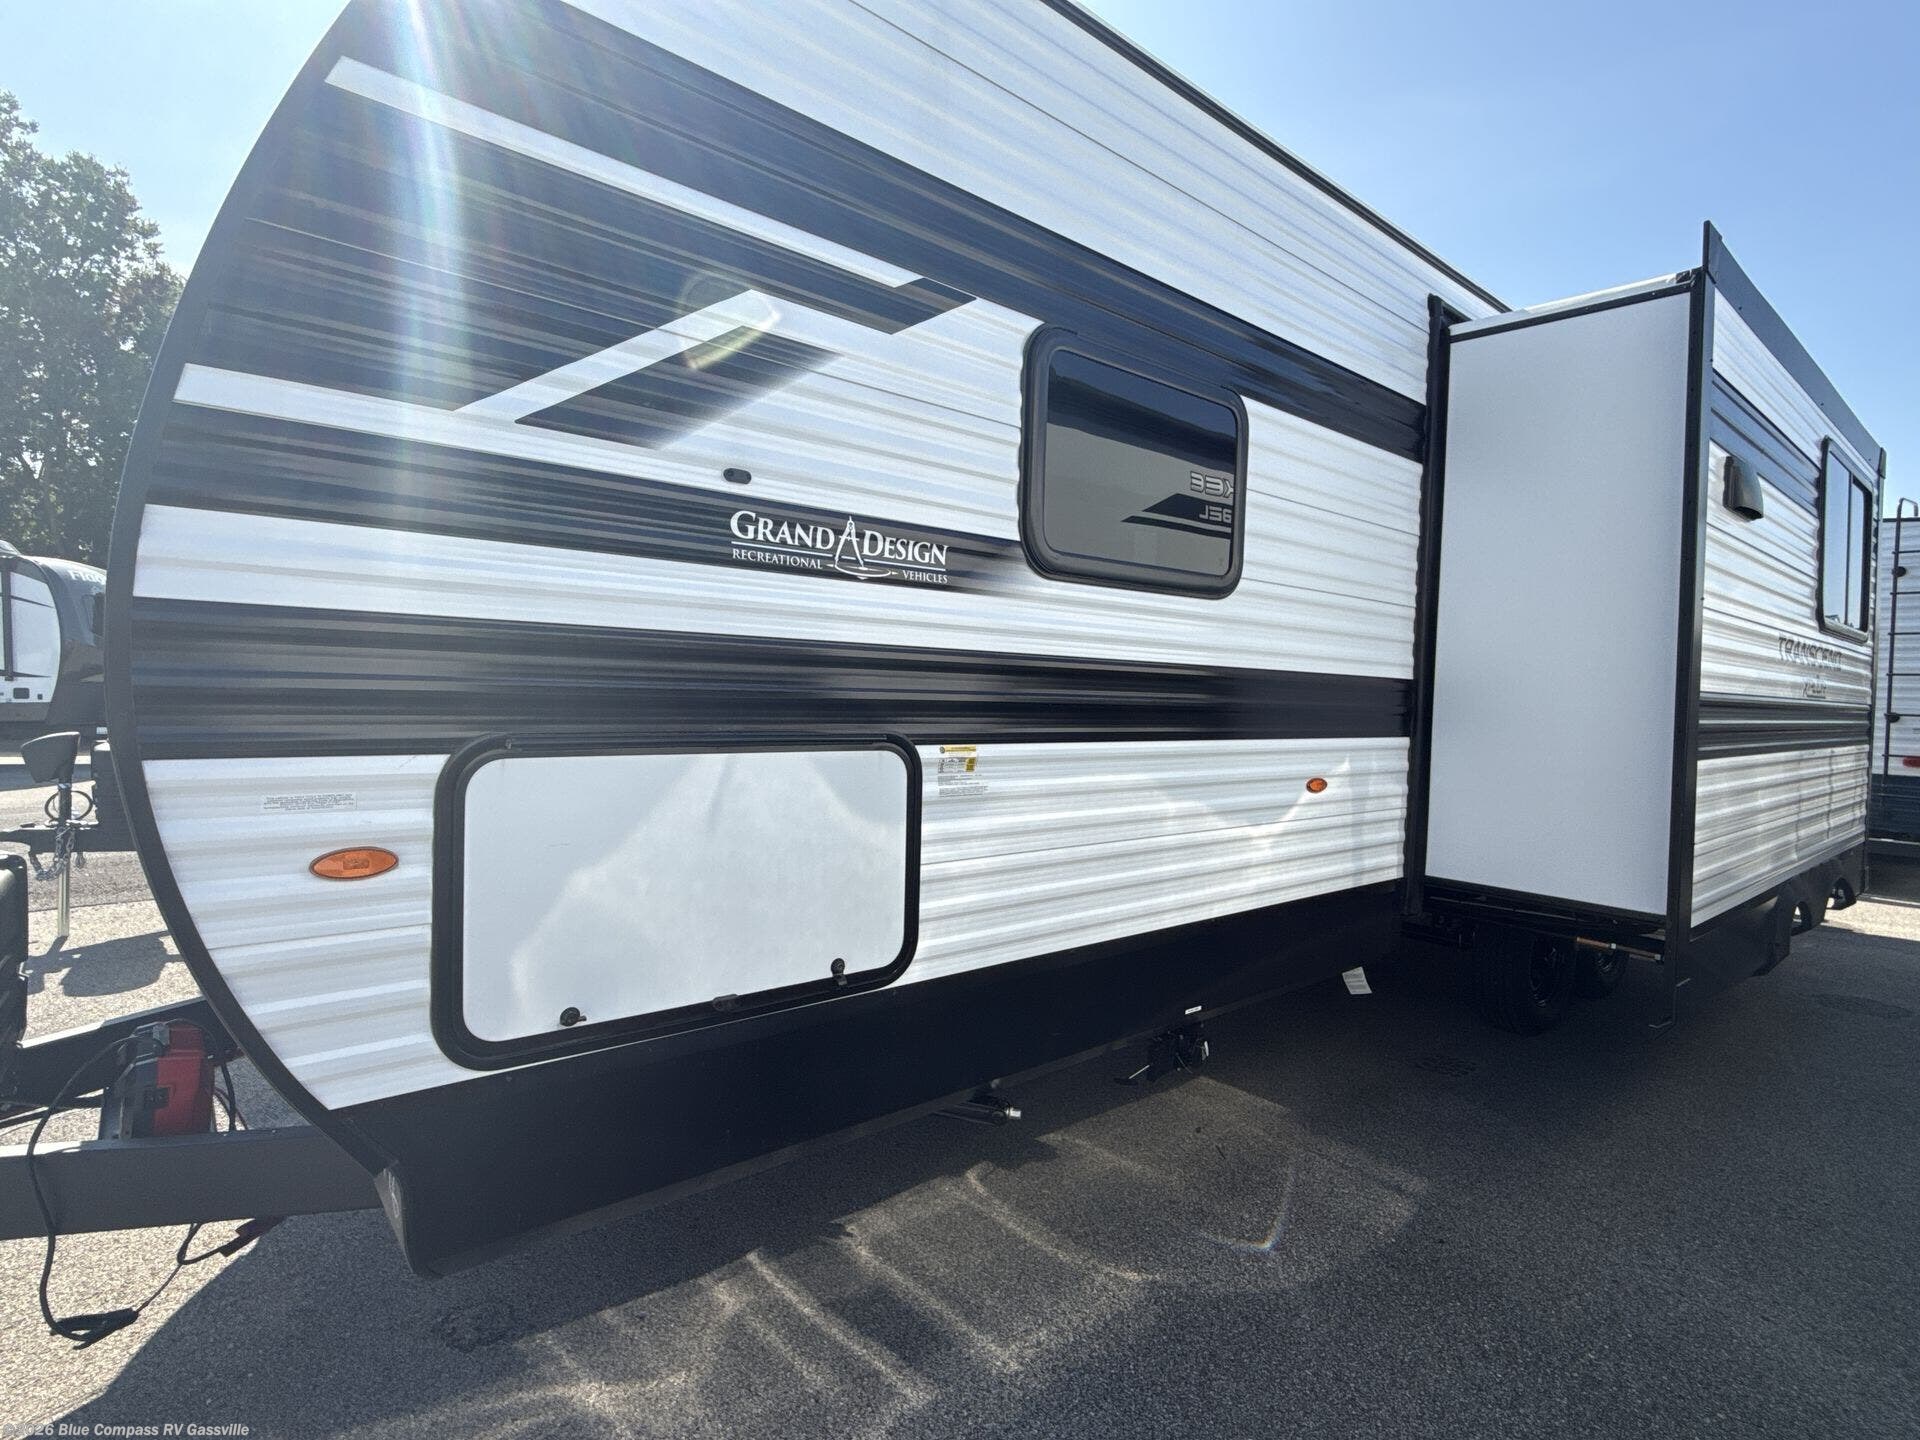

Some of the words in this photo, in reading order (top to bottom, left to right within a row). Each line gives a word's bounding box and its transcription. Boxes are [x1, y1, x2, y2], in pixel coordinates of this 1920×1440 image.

[730, 510, 835, 550] GRAND
[863, 529, 949, 566] DESIGN
[732, 548, 823, 570] RECREATIONAL
[903, 569, 948, 584] VEHICLES
